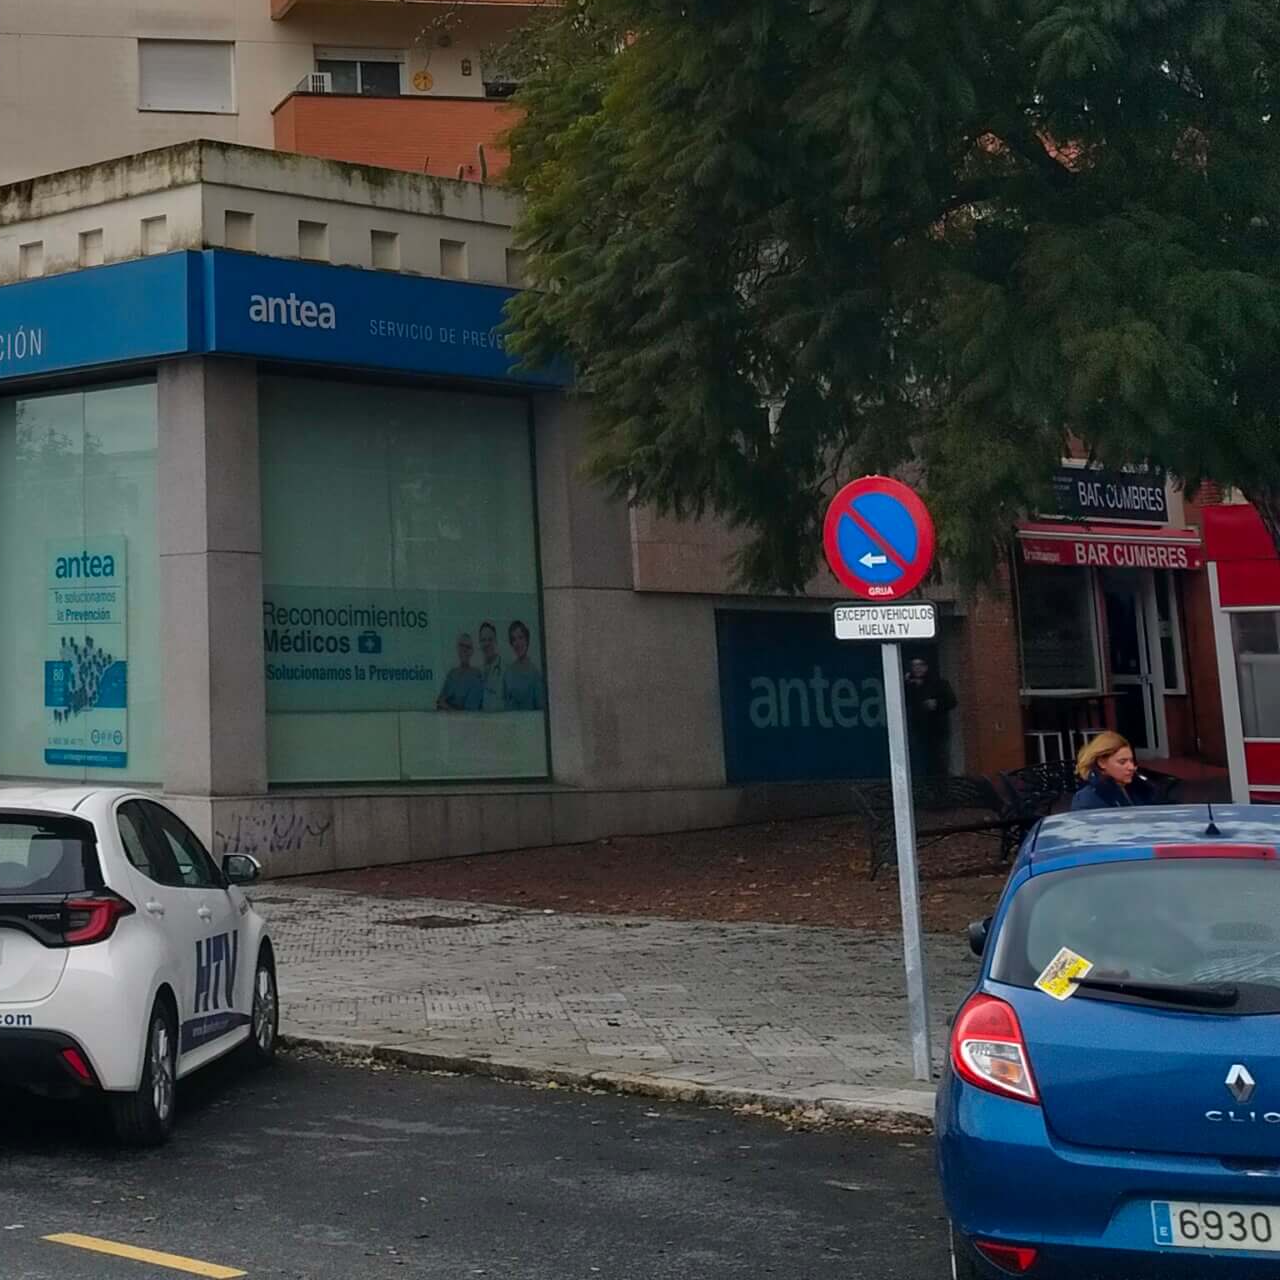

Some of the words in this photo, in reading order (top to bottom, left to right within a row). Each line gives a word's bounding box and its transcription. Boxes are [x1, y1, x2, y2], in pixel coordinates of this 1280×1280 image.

[249, 292, 336, 329] antea
[369, 319, 433, 342] SERVICIO
[439, 328, 456, 344] DE
[463, 329, 505, 350] PREVE
[1077, 481, 1105, 507] BAR
[1105, 483, 1164, 512] CUMBRES
[55, 550, 115, 579] antea
[1074, 542, 1111, 565] BAR
[1113, 544, 1188, 568] CUMBRES
[868, 586, 894, 596] GRUA
[263, 601, 429, 629] Reconocimientos
[836, 608, 878, 621] EXCEPTO
[879, 607, 935, 620] VEHICULOS
[263, 628, 351, 655] Médicos
[858, 624, 896, 636] HUELVA
[897, 623, 910, 635] TV
[265, 663, 352, 681] Solucionamos
[354, 665, 366, 681] la
[369, 664, 433, 681] Prevención
[749, 665, 887, 729] antea
[1205, 1110, 1280, 1123] CLIO
[1179, 1209, 1272, 1243] 6930
